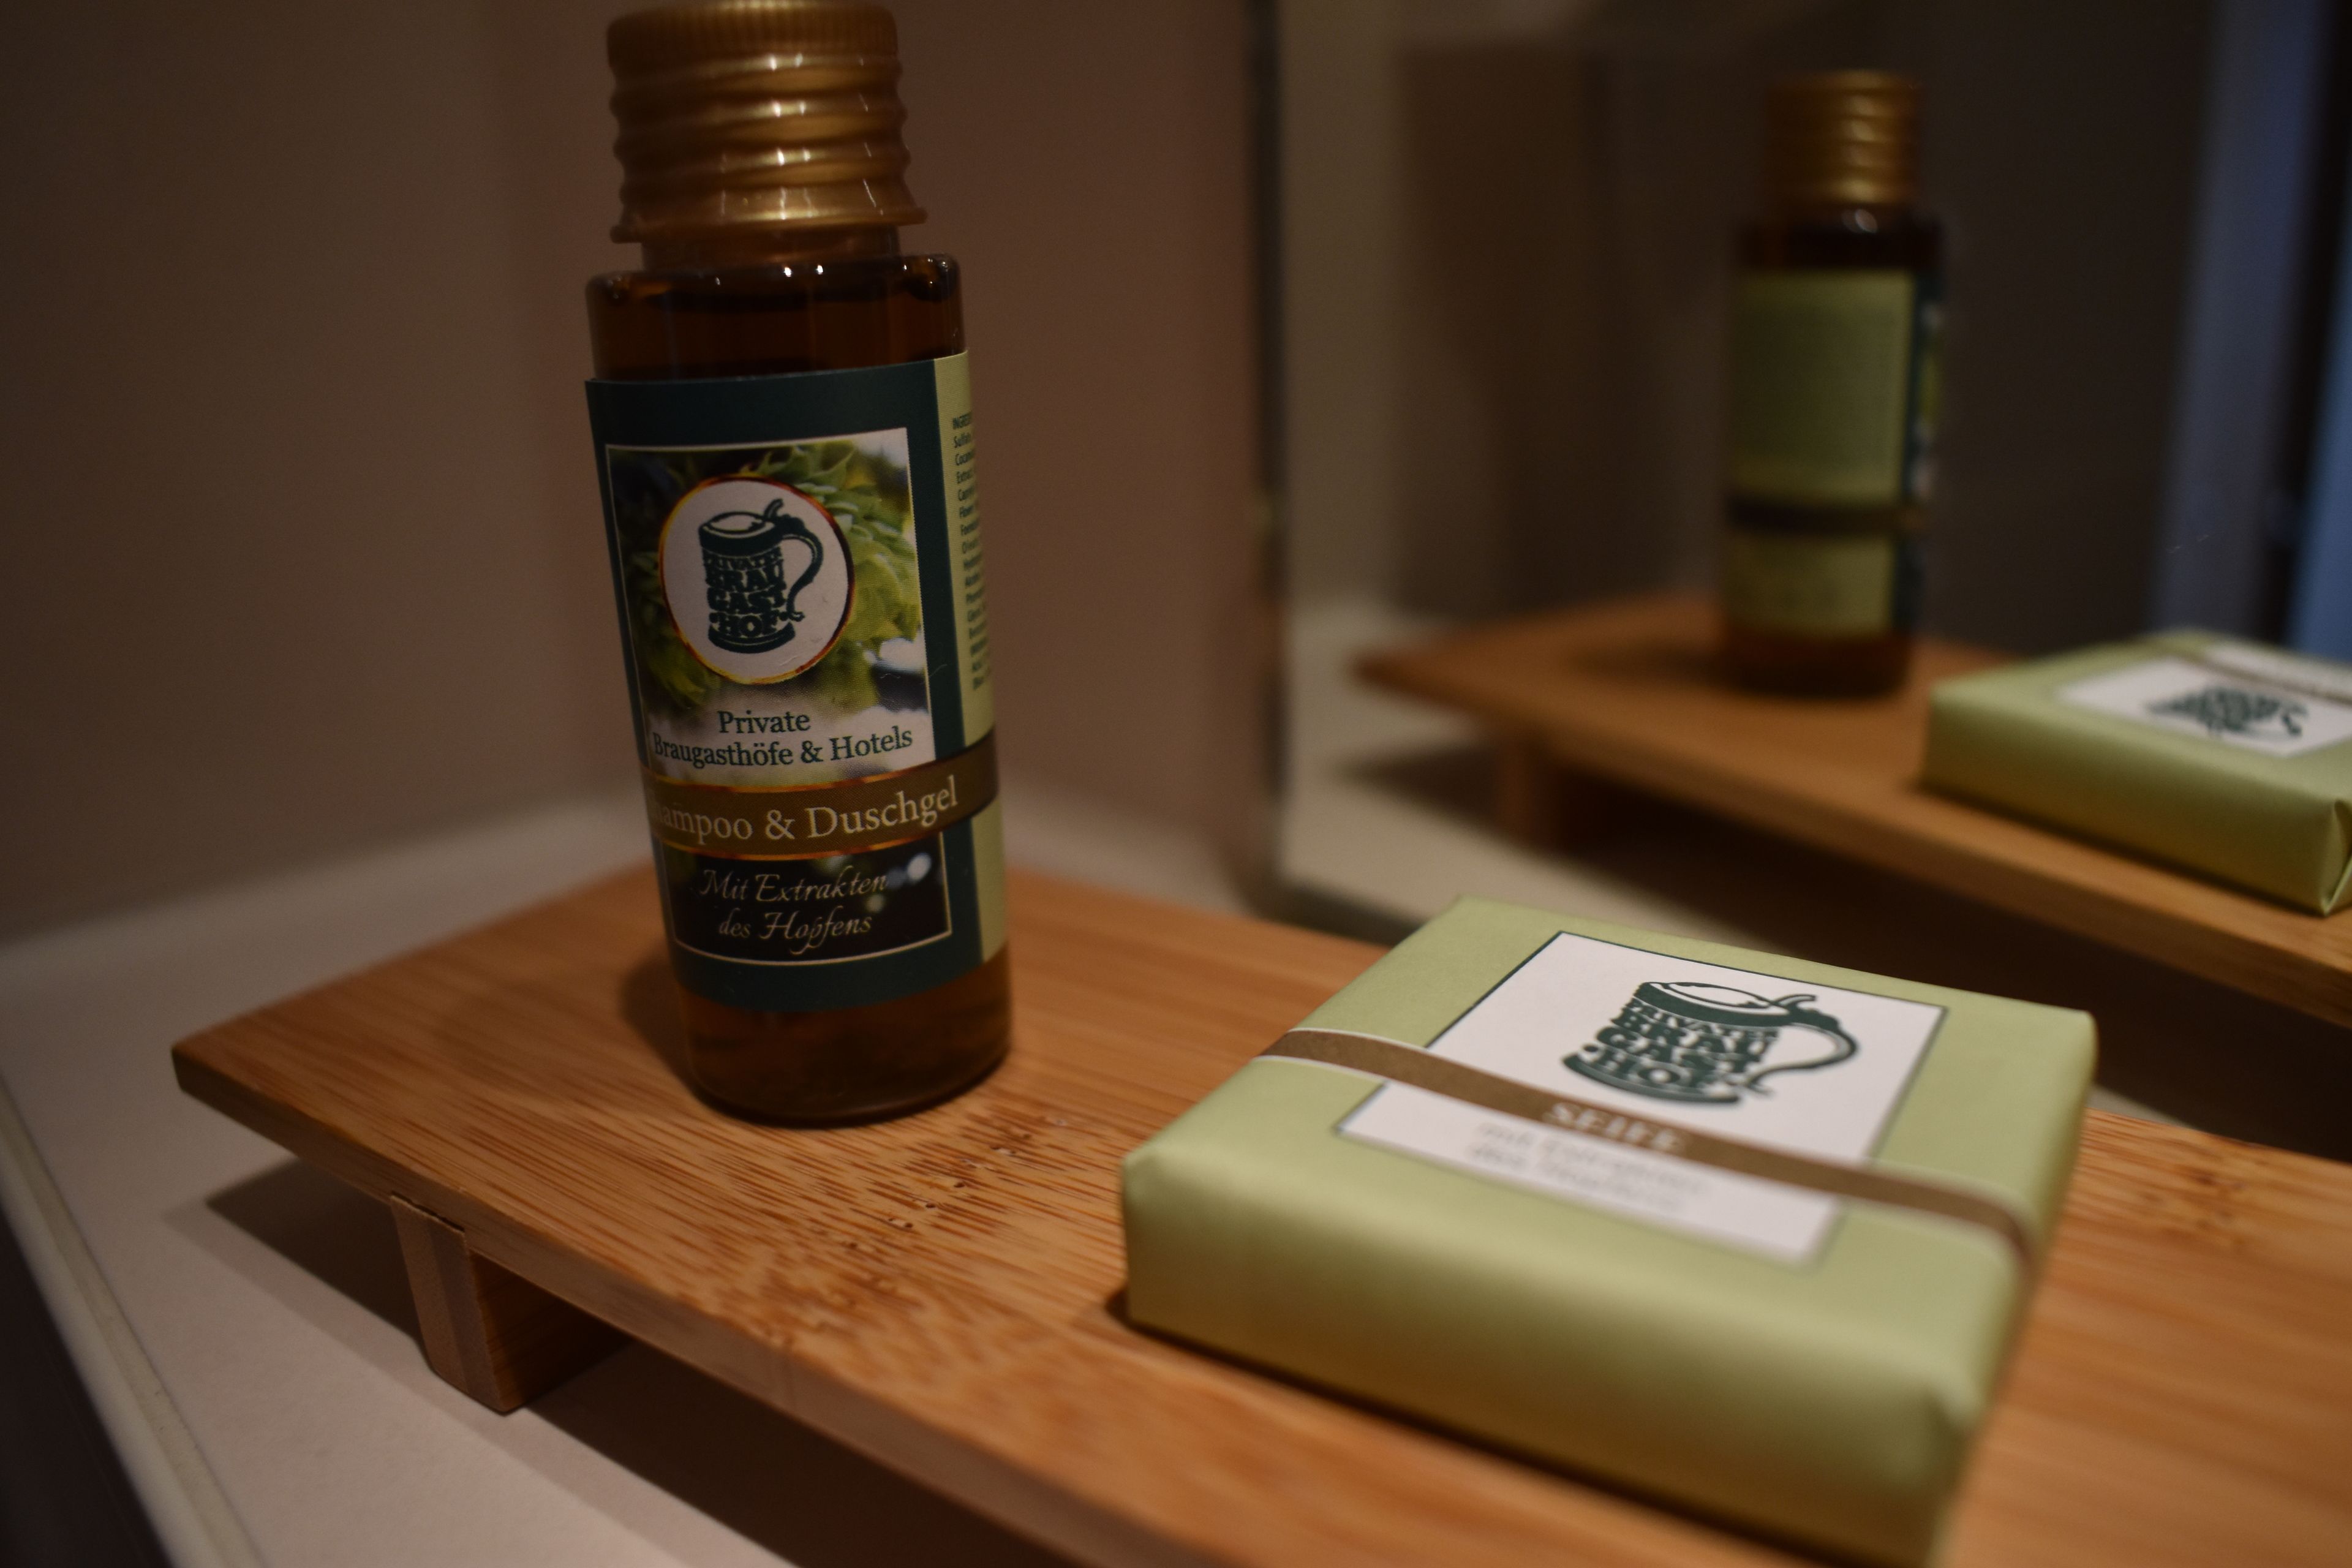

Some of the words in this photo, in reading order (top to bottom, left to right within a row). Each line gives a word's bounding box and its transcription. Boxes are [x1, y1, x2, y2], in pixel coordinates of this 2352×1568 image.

[717, 710, 811, 734] Private
[652, 731, 794, 769] Braugasthöfe
[801, 739, 823, 763] &
[830, 726, 913, 761] Hotels
[659, 804, 753, 846] ampoo
[764, 809, 795, 840] &
[805, 774, 959, 840] Duschgel
[698, 869, 749, 902] Mit
[754, 865, 888, 904] Extrakten
[718, 908, 751, 938] des
[759, 905, 872, 955] Hopfens
